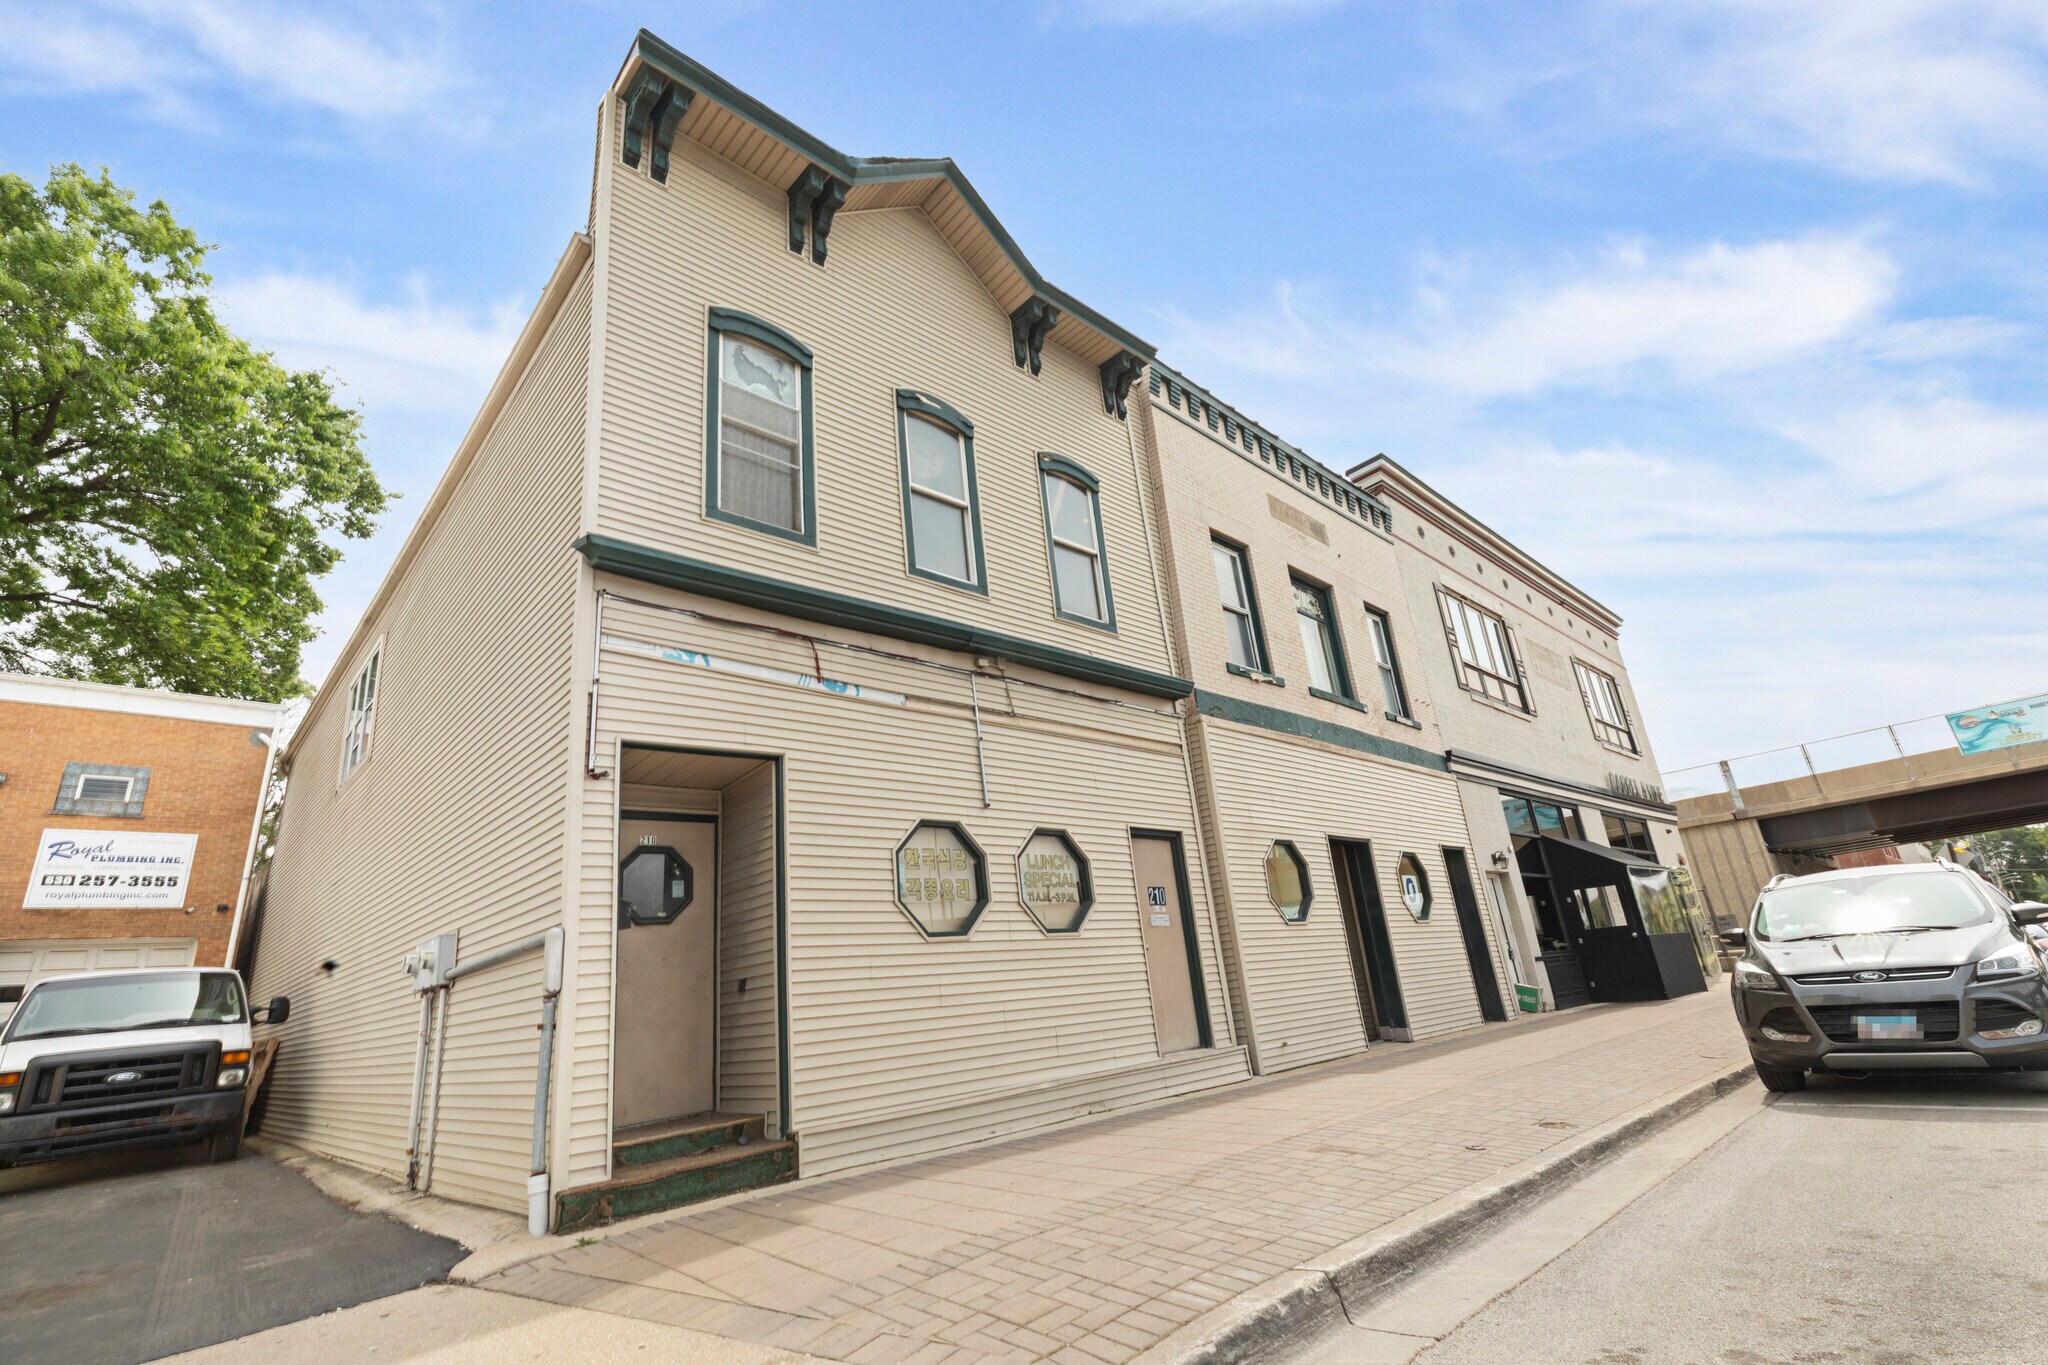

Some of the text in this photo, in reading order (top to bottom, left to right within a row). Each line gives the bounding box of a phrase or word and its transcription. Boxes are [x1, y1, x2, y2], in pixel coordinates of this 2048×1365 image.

[641, 836, 656, 844] 210
[48, 840, 114, 861] Royal
[91, 855, 185, 864] PLUMBING INC.
[904, 848, 967, 871] 한국식당
[1026, 853, 1071, 870] LUNCH
[79, 875, 179, 887] 257-3555
[1024, 871, 1077, 888] SPECIAL
[45, 891, 169, 900] royalplumbinginc.com
[905, 878, 970, 901] 각종요리
[1148, 887, 1166, 905] 210
